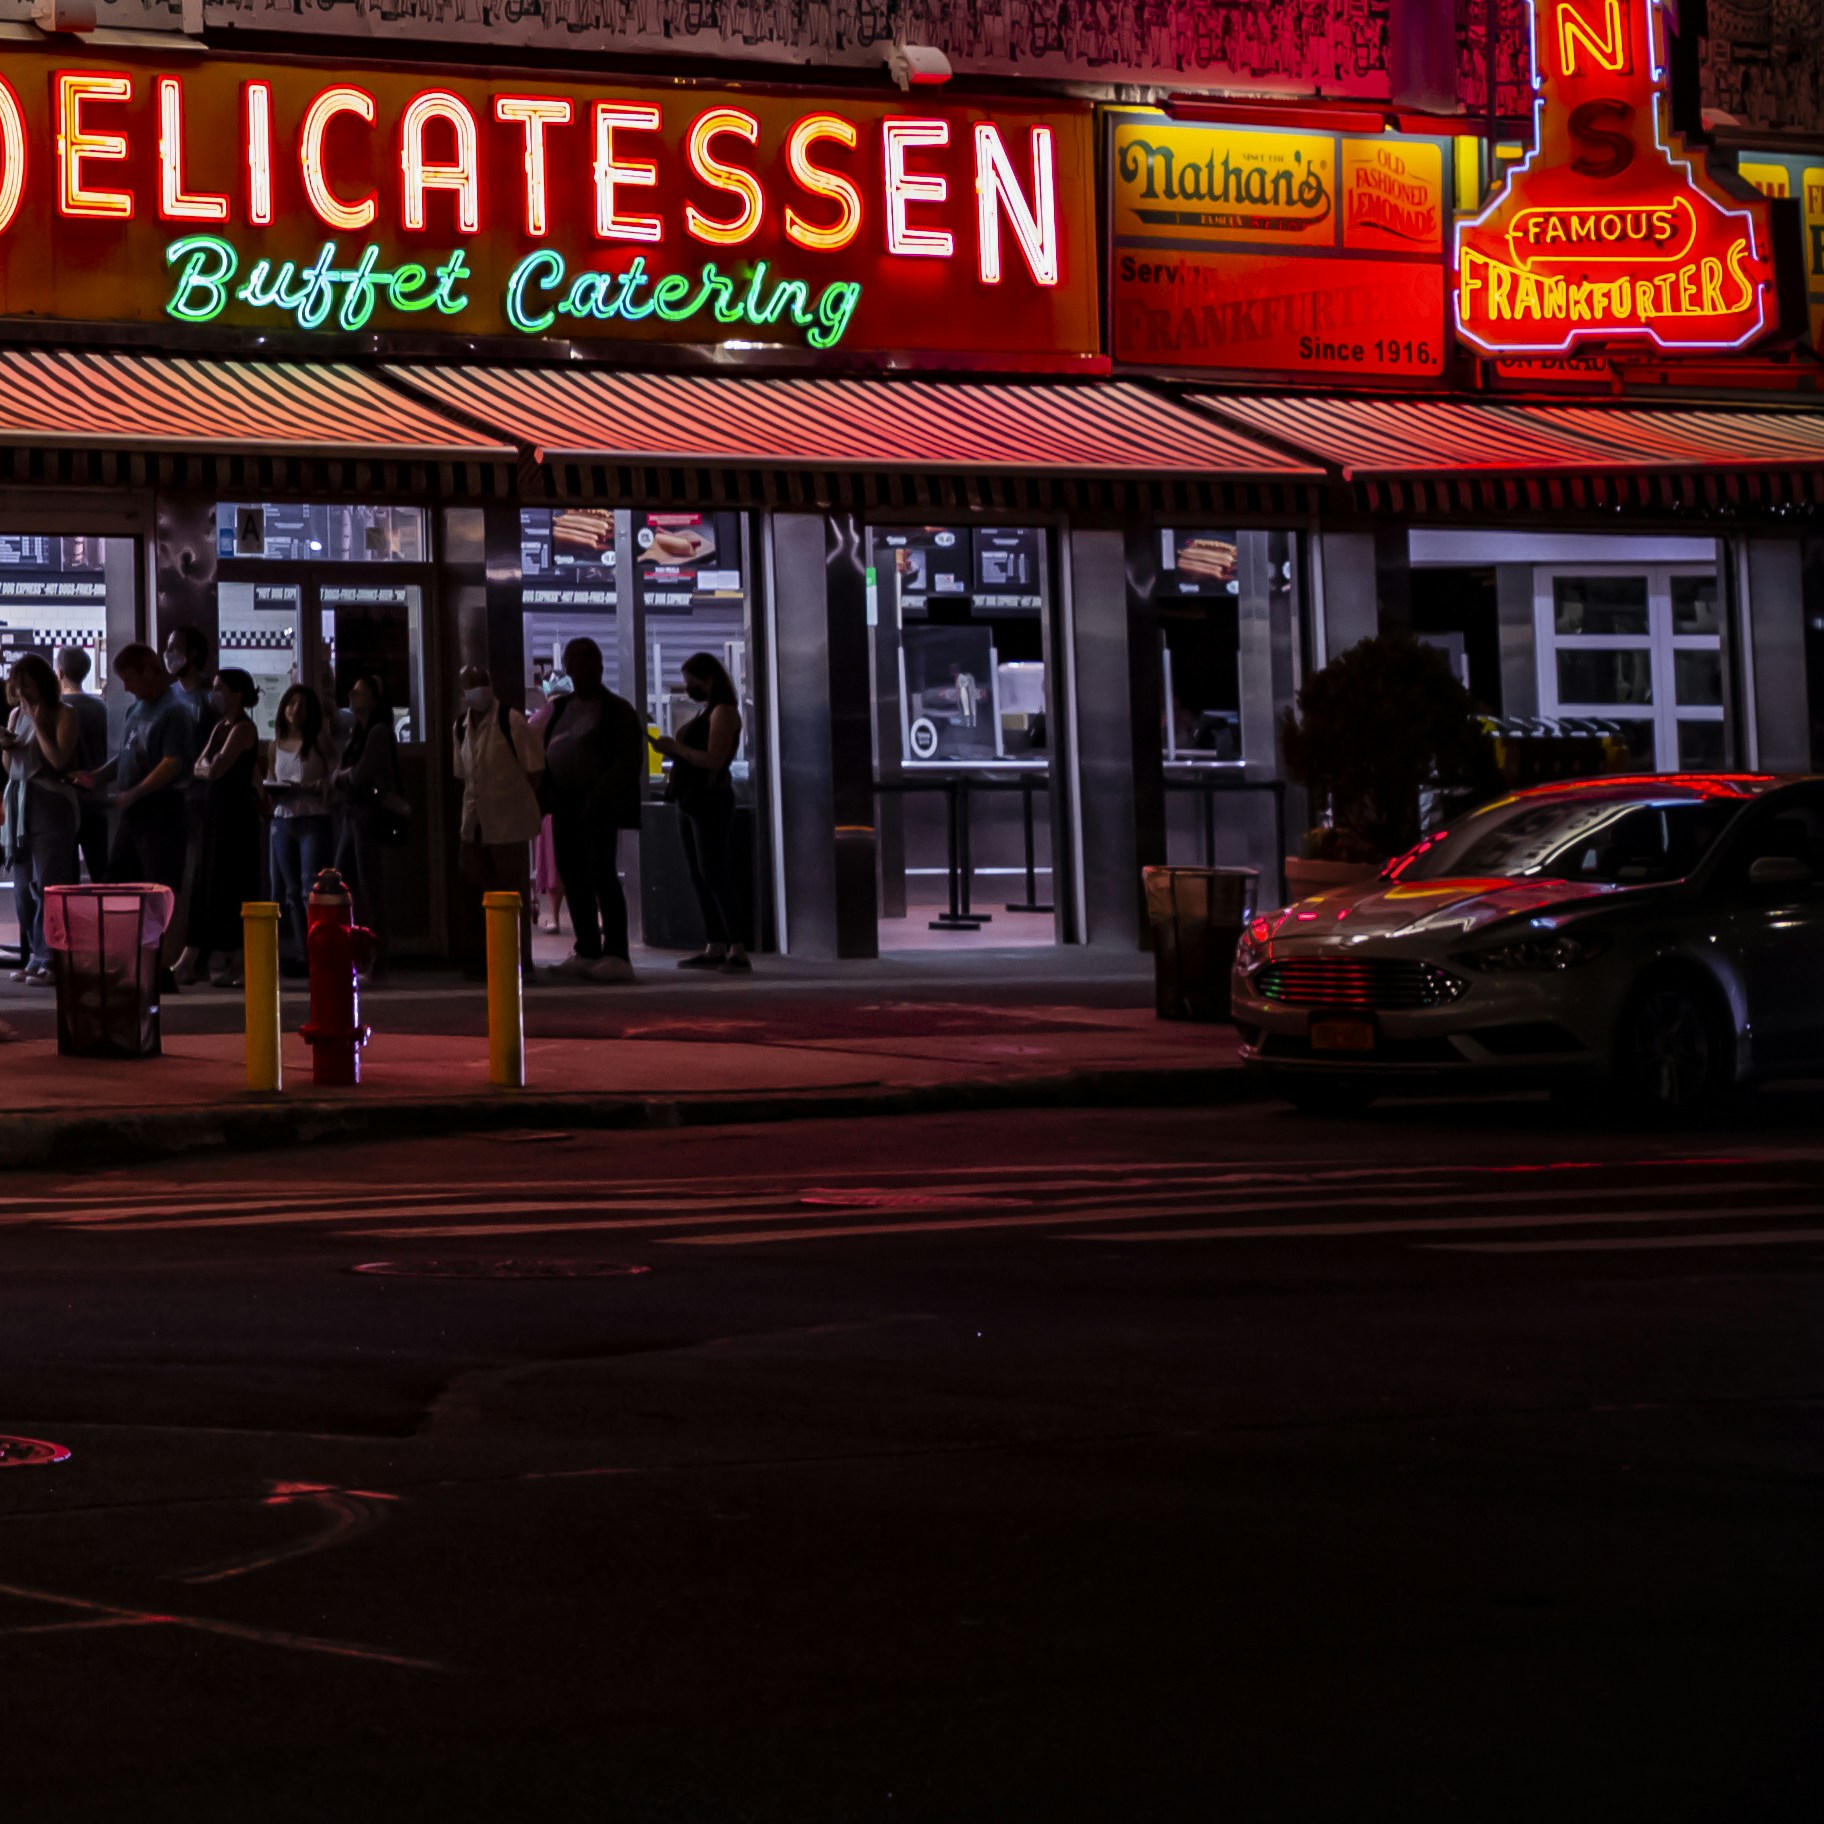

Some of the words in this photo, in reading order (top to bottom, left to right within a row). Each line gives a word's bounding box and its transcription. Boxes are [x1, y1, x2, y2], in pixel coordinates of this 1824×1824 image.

[1118, 139, 1331, 209] Nathan's
[1377, 148, 1407, 176] OLD
[1355, 168, 1429, 207] FASHIONED
[1348, 188, 1437, 237] LEMONADE
[1528, 212, 1674, 244] FAMOUS
[164, 234, 469, 330] Buffet
[505, 248, 861, 349] Catering
[1458, 237, 1754, 323] FRANKFURTERS
[1297, 336, 1365, 363] Since
[1372, 339, 1439, 366] 1916.
[241, 513, 261, 541] A
